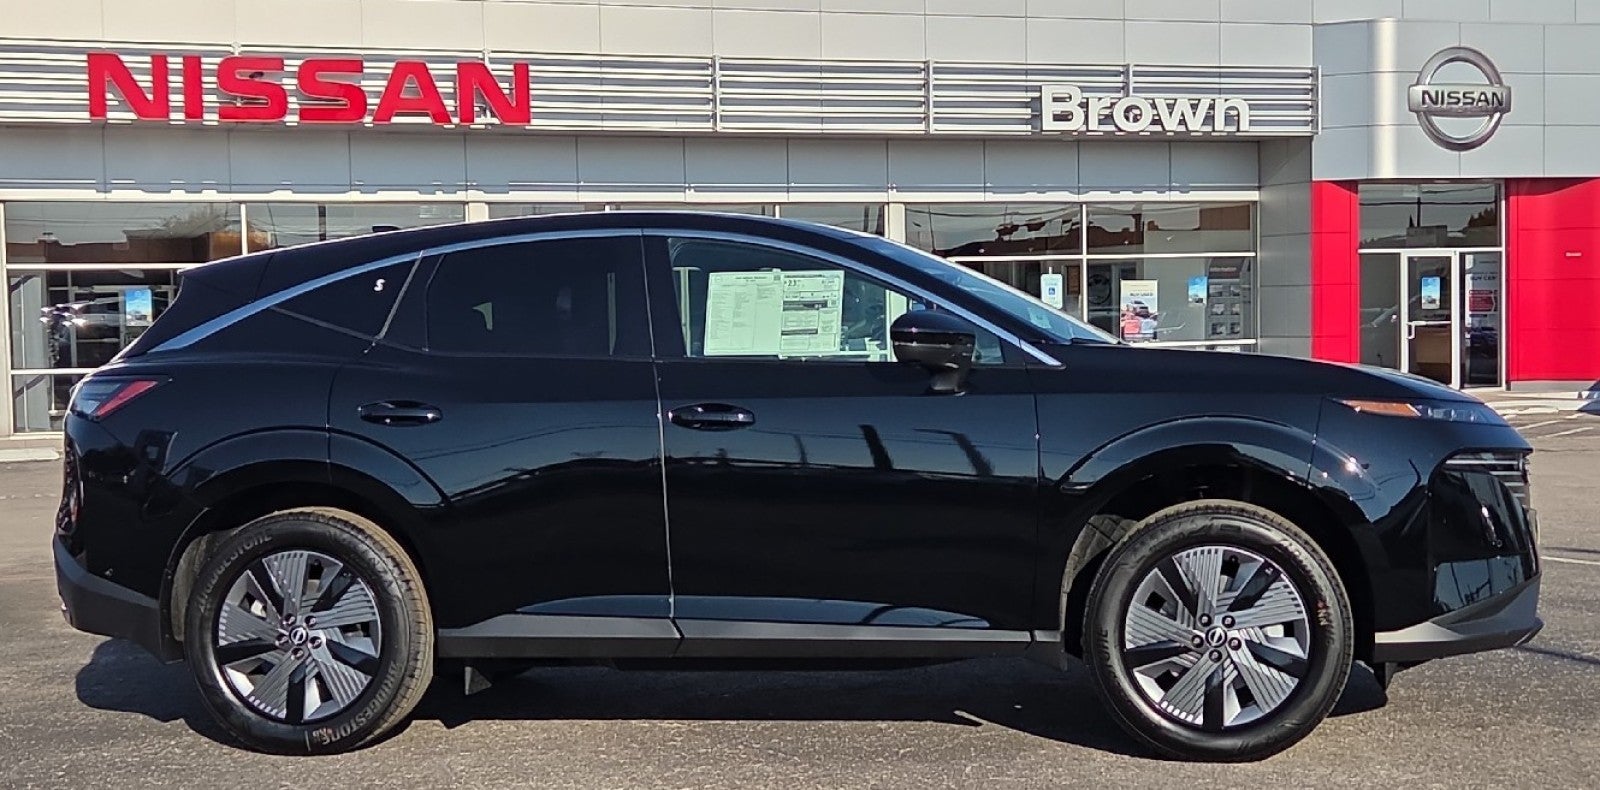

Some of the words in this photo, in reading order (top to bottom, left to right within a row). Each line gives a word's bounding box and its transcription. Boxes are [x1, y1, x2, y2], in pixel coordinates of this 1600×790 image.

[86, 51, 532, 126] NISSAN
[1420, 88, 1505, 108] NISSAN
[1040, 84, 1251, 134] Brown
[373, 278, 386, 292] S
